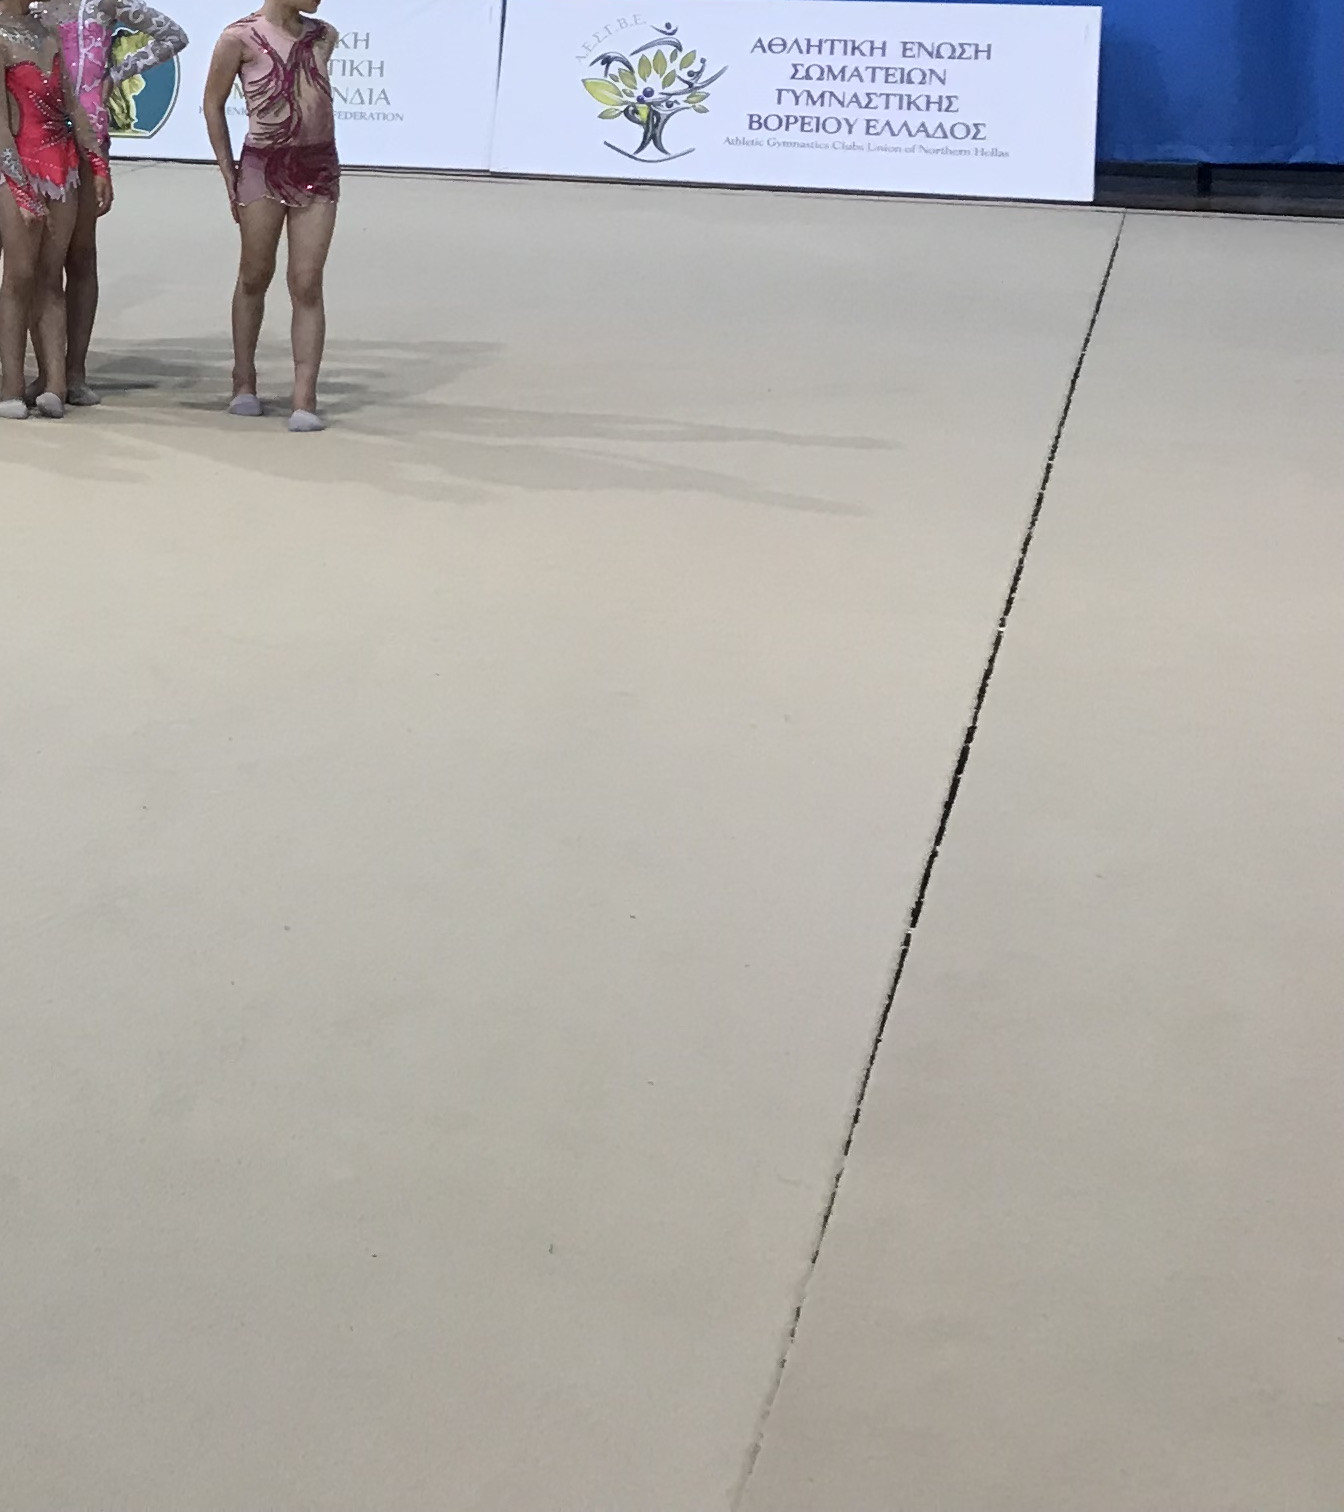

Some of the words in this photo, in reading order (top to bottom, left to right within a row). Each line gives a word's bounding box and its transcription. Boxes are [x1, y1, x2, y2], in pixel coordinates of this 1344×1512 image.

[750, 37, 887, 57] ΑΘΛΗΤΙΚΗ
[900, 41, 992, 61] ΕΝΩΣΗ
[790, 63, 946, 86] ΣΩΜΑΤΕΙΩΝ
[776, 88, 959, 113] ΓΥΜΝΑΣΤΙΚΗΣ
[747, 113, 858, 135] ΒΟΡΕΙΟΥ
[865, 119, 987, 141] ΕΛΛΑΔΟΣ
[723, 136, 763, 147] Athletic
[767, 137, 829, 150] Gymnastics
